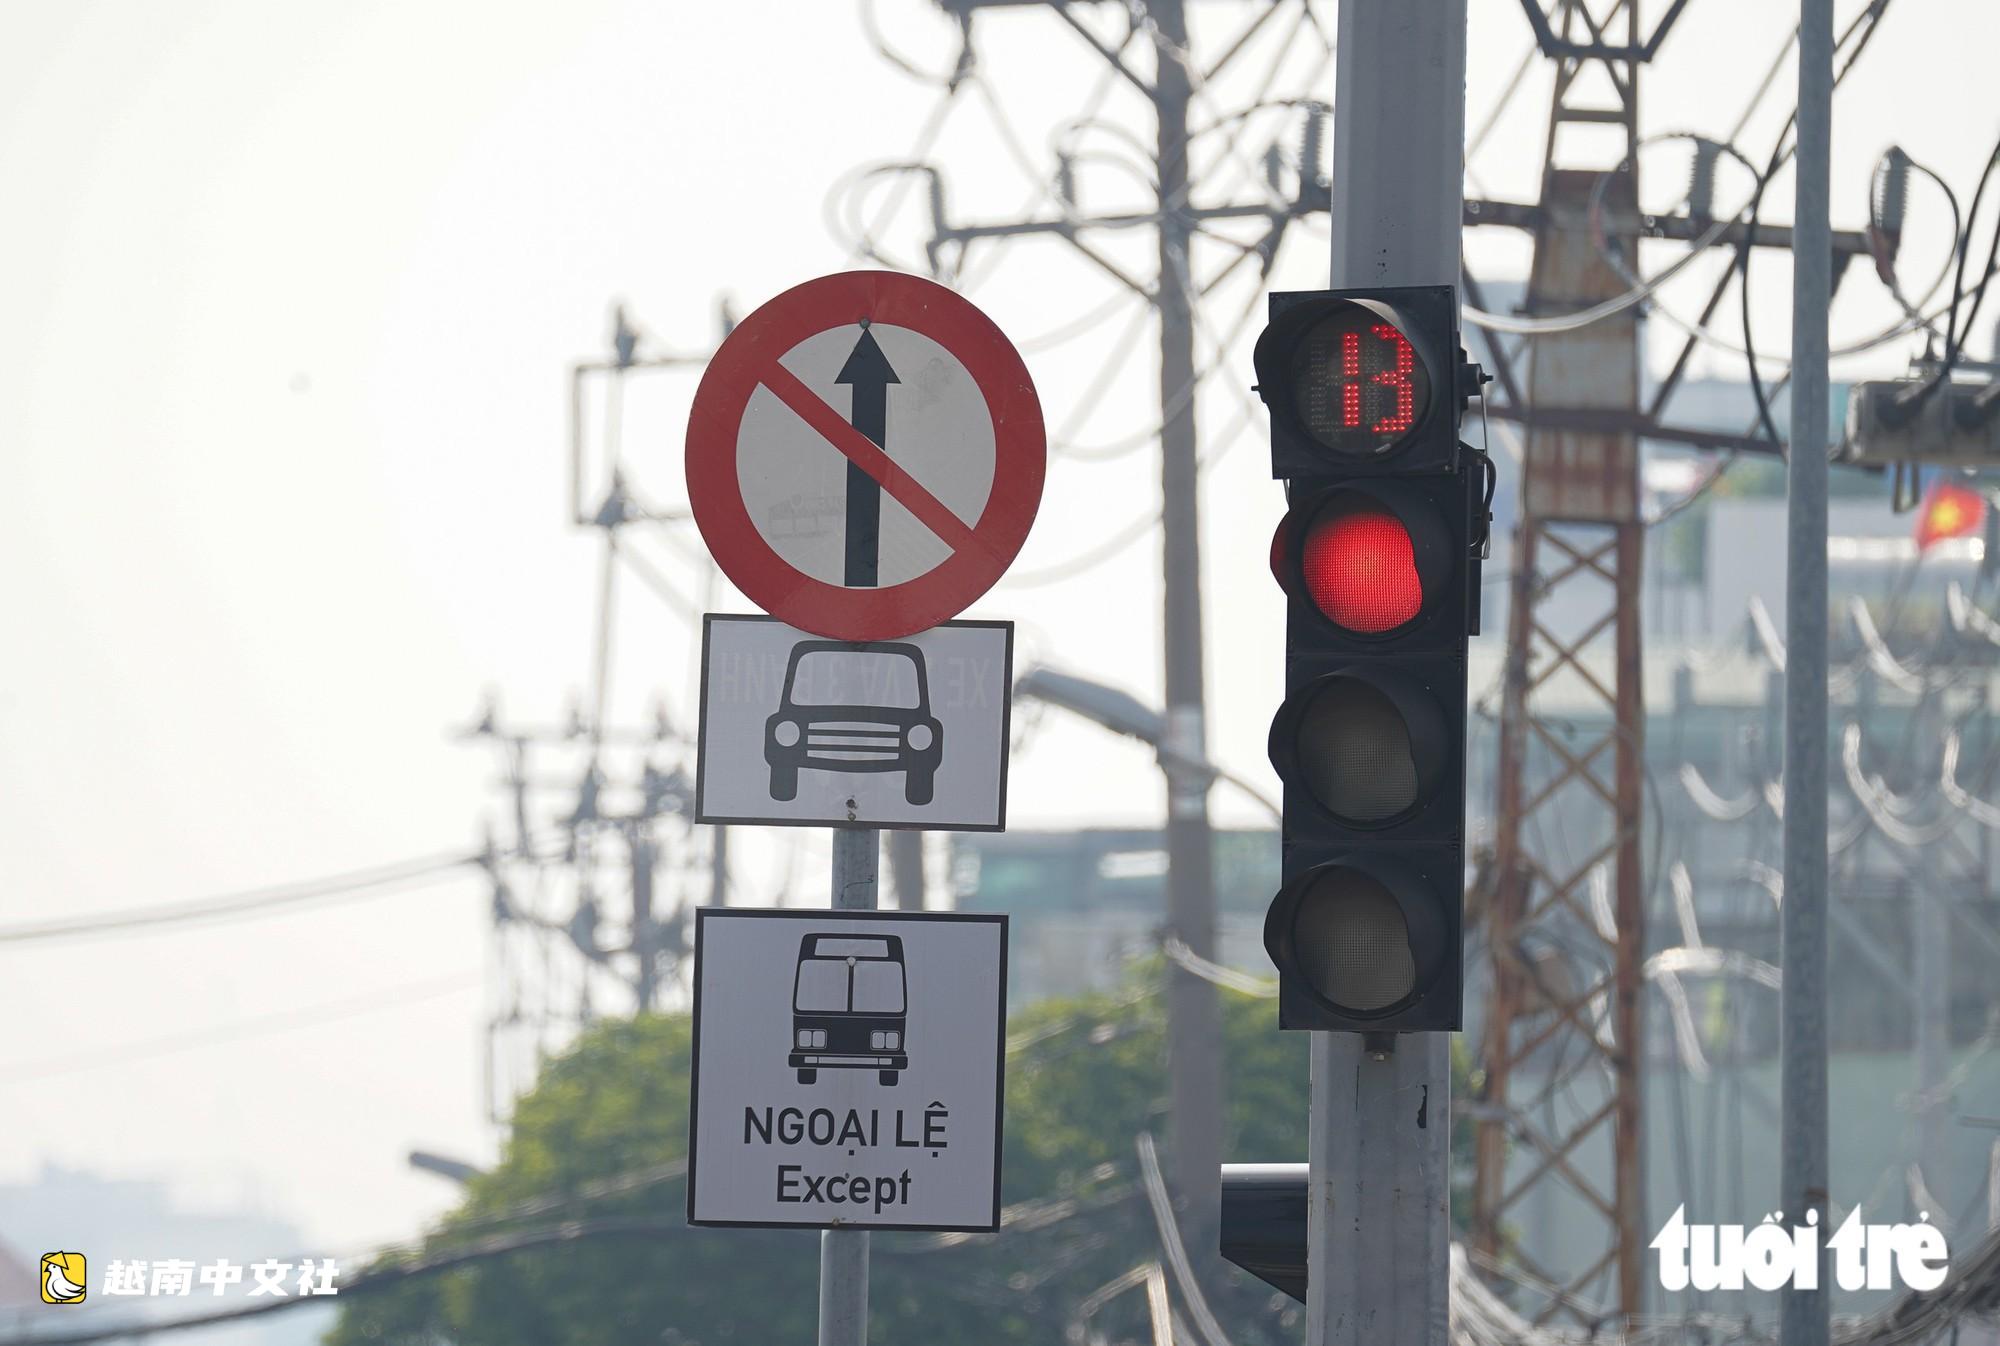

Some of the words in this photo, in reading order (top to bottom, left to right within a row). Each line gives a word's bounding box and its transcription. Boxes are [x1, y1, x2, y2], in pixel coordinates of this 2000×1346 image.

[1343, 325, 1413, 432] 13
[744, 1106, 879, 1156] NGOẠI
[895, 1101, 949, 1158] LỆ
[776, 1165, 912, 1214] Except
